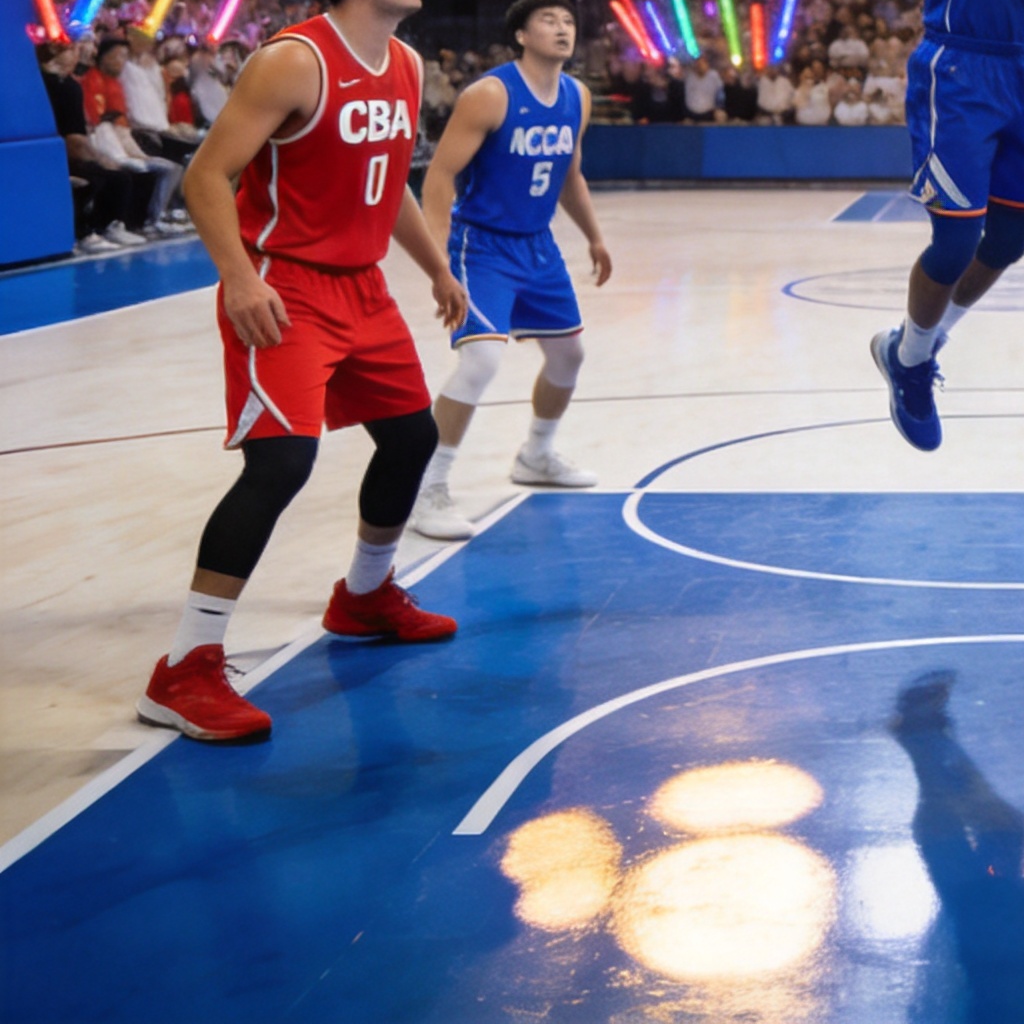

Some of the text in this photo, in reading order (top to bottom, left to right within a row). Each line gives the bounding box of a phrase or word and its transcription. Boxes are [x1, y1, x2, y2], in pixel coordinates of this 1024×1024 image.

[339, 99, 412, 145] CBA
[364, 153, 389, 207] 0
[529, 161, 553, 197] 5
